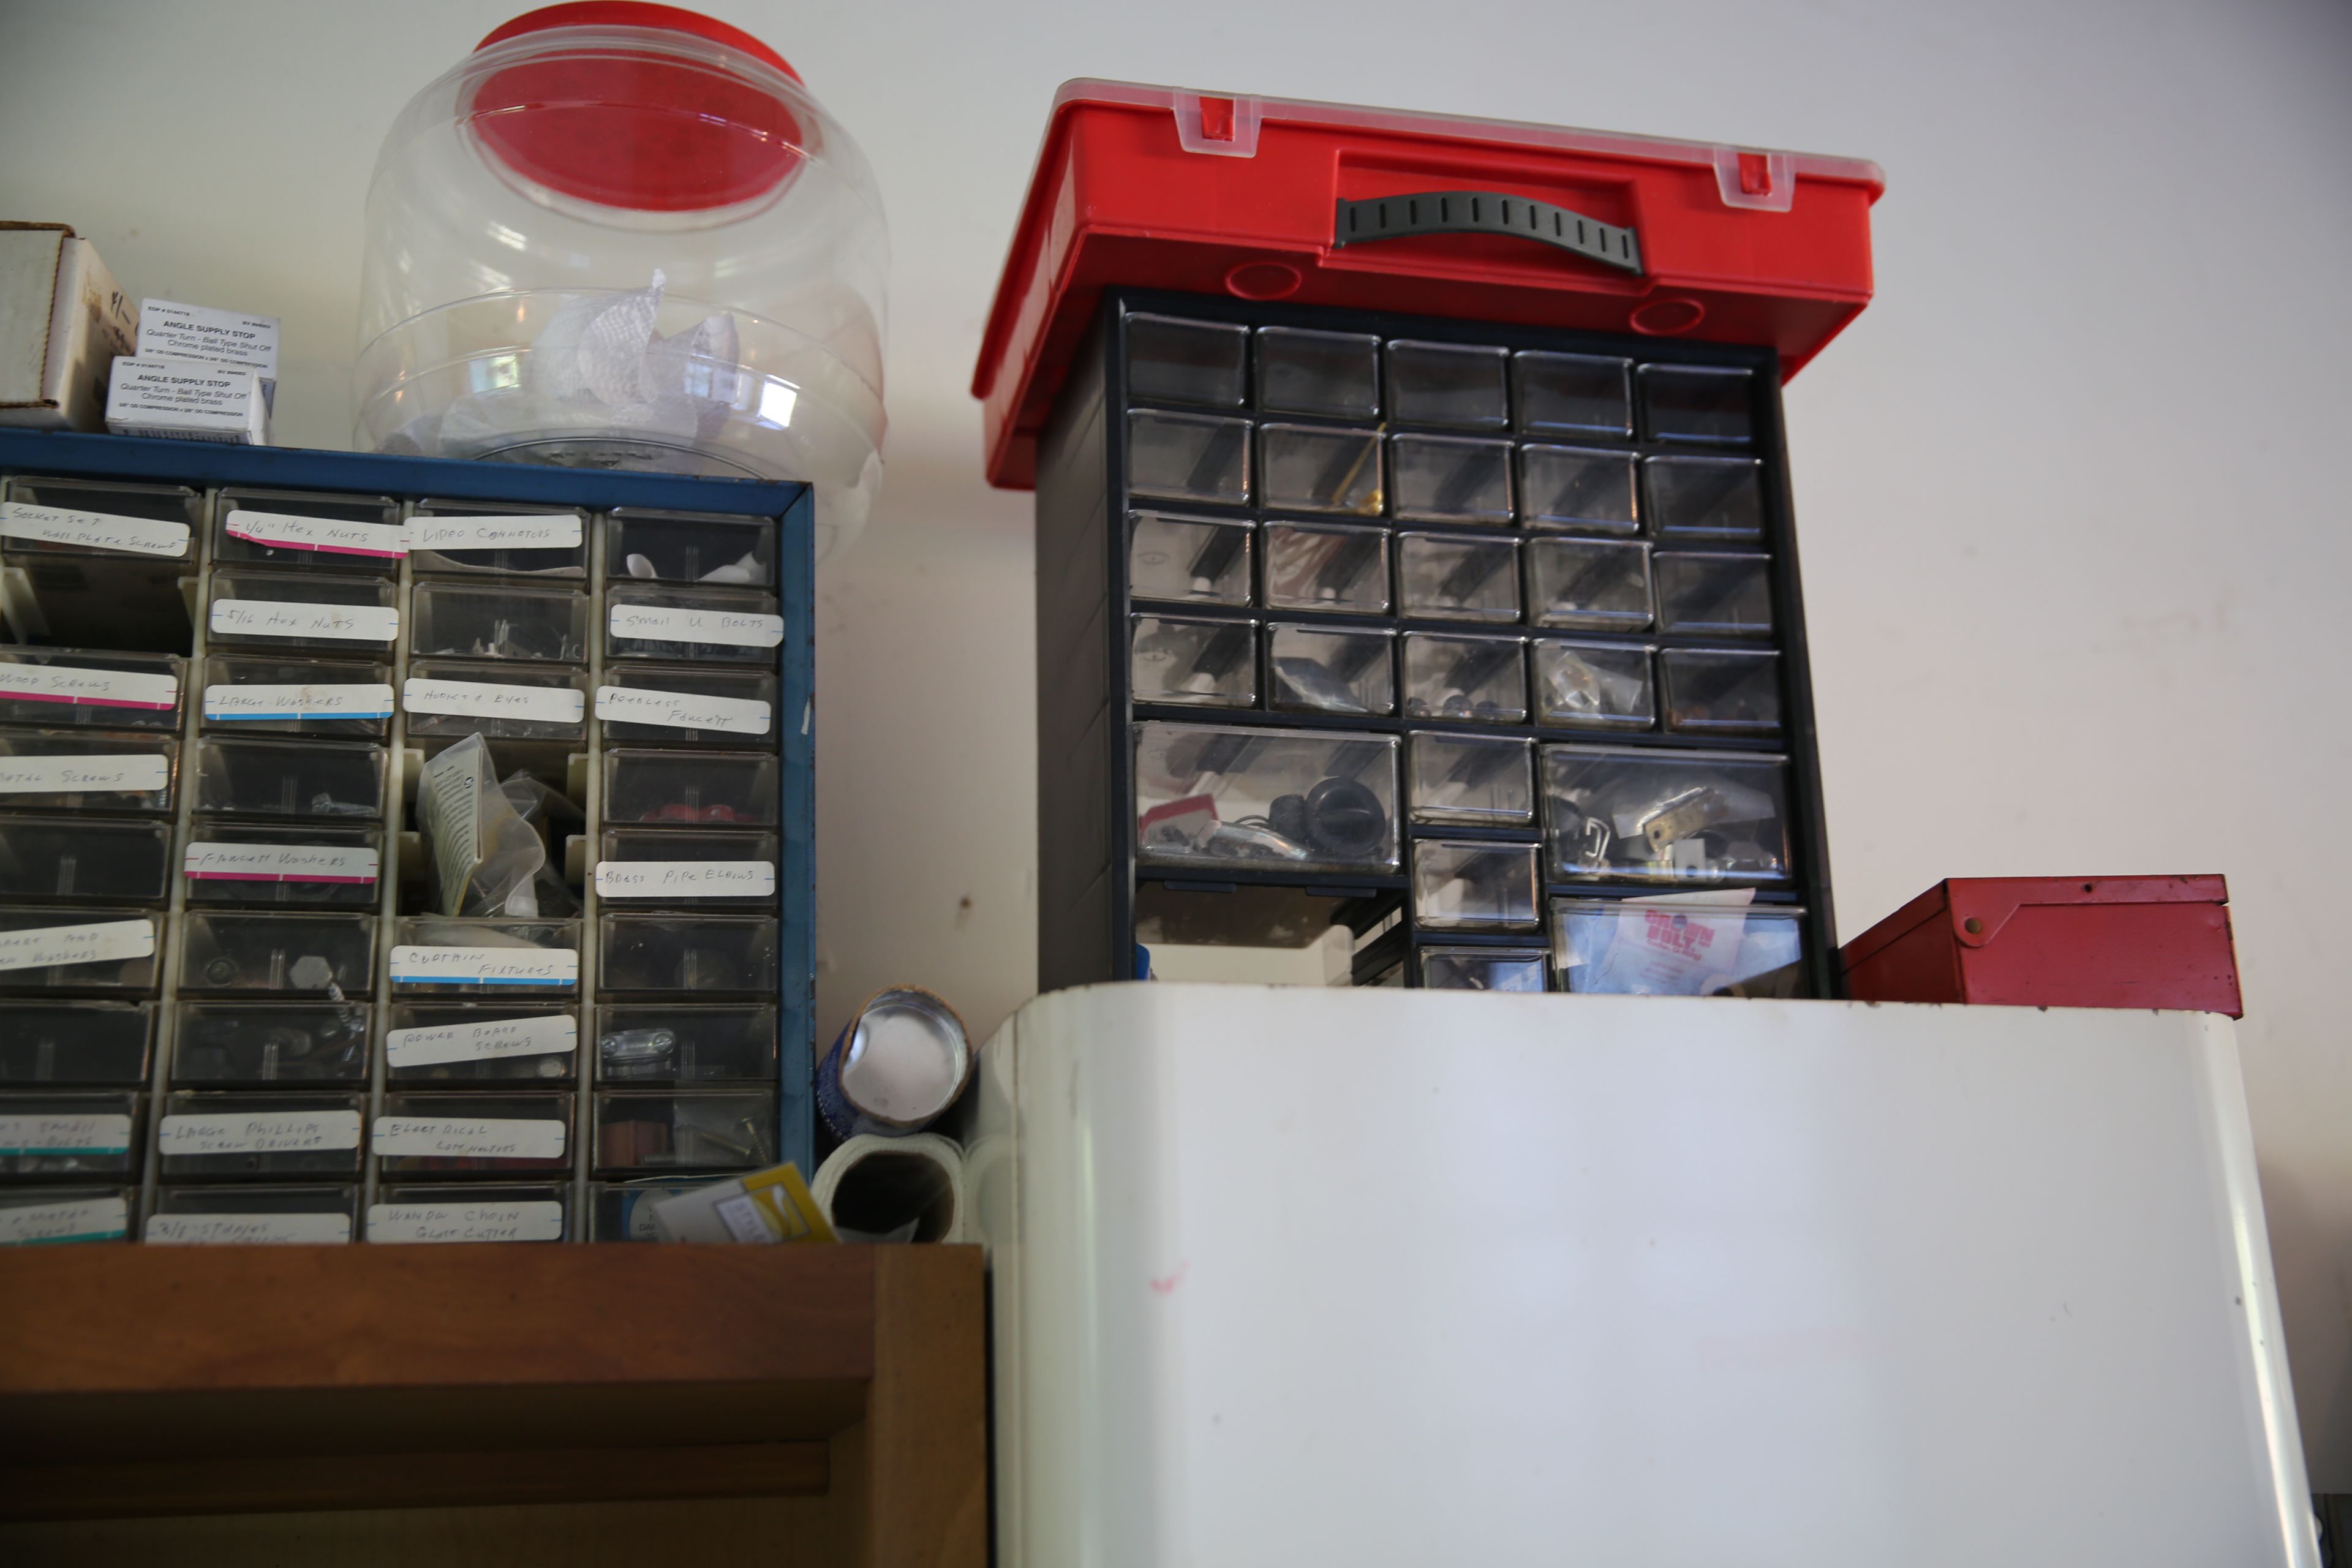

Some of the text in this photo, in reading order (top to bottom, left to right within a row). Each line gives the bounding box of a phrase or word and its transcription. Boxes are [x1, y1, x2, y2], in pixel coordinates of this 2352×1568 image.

[164, 320, 256, 339] ANGLE SUPPLY STOP
[146, 328, 177, 339] Quarter
[179, 333, 196, 341] Turn
[220, 339, 238, 349] Type
[239, 341, 258, 350] Shut
[168, 339, 249, 356] Chrome plated brass
[165, 350, 205, 360] COMPRESSION
[230, 358, 268, 369] COMPRESSION
[137, 374, 169, 383] ANGLE
[170, 377, 206, 386] SUPPLY
[120, 383, 151, 391] Quarter
[194, 389, 213, 398] Type
[141, 393, 173, 402] Chrome
[140, 404, 179, 412] COMPRESSION
[204, 409, 244, 417] COMPRESSION
